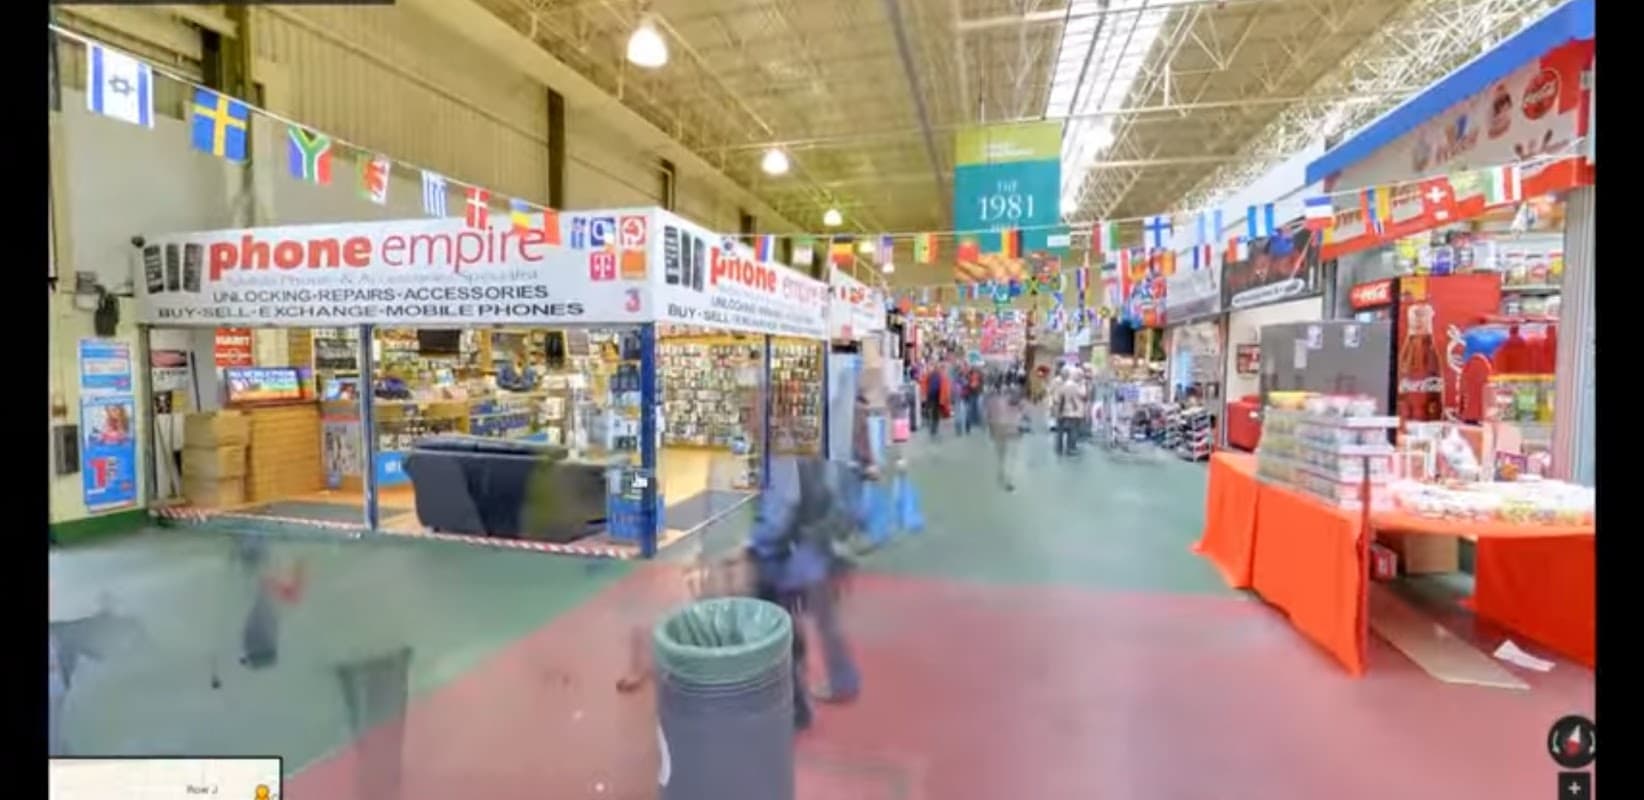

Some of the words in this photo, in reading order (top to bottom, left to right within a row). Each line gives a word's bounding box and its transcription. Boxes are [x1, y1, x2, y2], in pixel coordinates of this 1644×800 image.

[979, 194, 1034, 221] 1981
[209, 234, 372, 281] phone
[381, 226, 545, 274] empire
[710, 246, 777, 293] phone
[478, 302, 584, 317] PHONES
[667, 303, 696, 319] BUY
